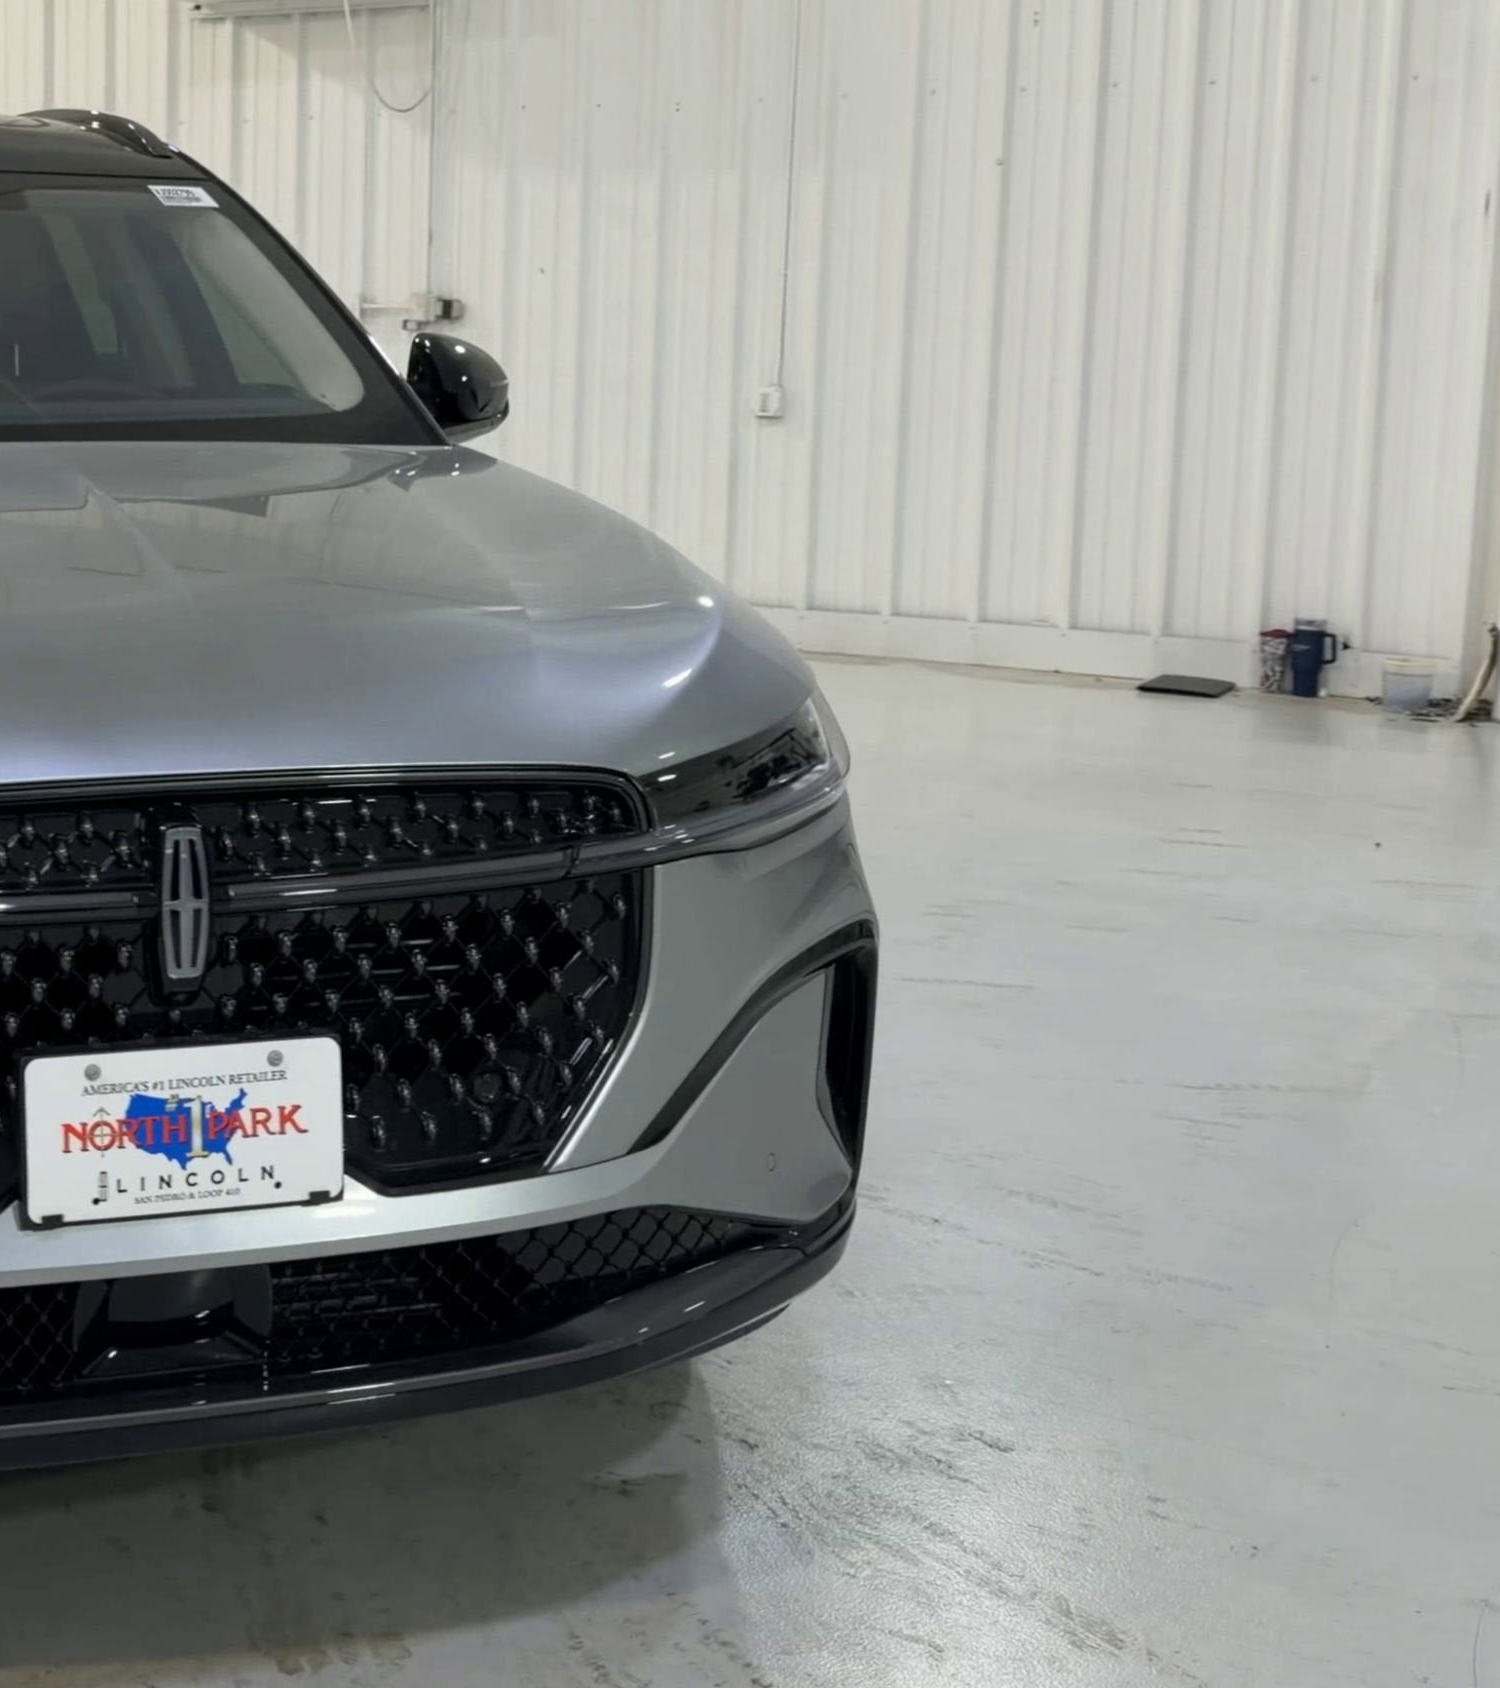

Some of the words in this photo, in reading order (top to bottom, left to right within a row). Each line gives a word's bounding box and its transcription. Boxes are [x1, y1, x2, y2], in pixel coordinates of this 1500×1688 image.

[81, 1081, 149, 1096] AMERICA'S
[152, 1080, 165, 1091] #1
[168, 1074, 226, 1090] LINCOLN
[228, 1070, 288, 1085] RETAILER
[61, 1114, 188, 1153] NORTH
[206, 1104, 308, 1141] PARK
[116, 1165, 275, 1193] LINCOLN
